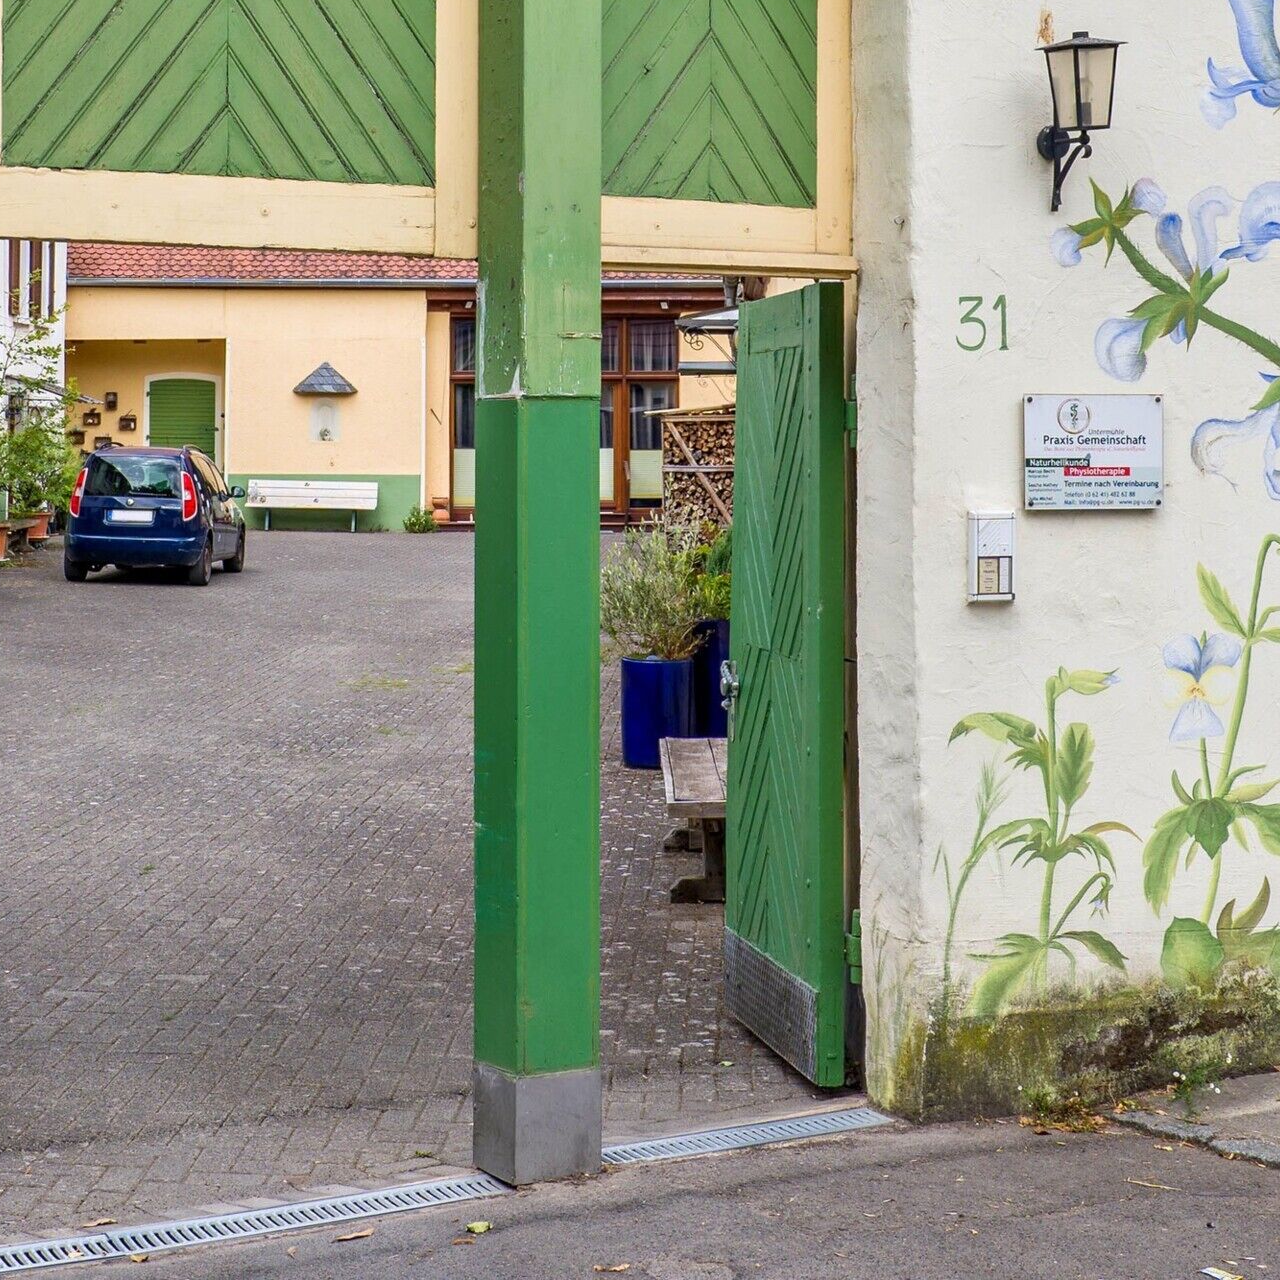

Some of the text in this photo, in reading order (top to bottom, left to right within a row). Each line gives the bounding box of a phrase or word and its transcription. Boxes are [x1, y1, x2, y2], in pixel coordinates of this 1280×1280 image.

[955, 294, 1010, 351] 31
[1088, 428, 1125, 436] Untermühle
[1043, 434, 1147, 445] Praxis Gemeinschaft
[1029, 459, 1089, 467] Naturheilkunde
[1069, 467, 1125, 477] Physiotherapie
[1113, 481, 1159, 489] Vereinbarung
